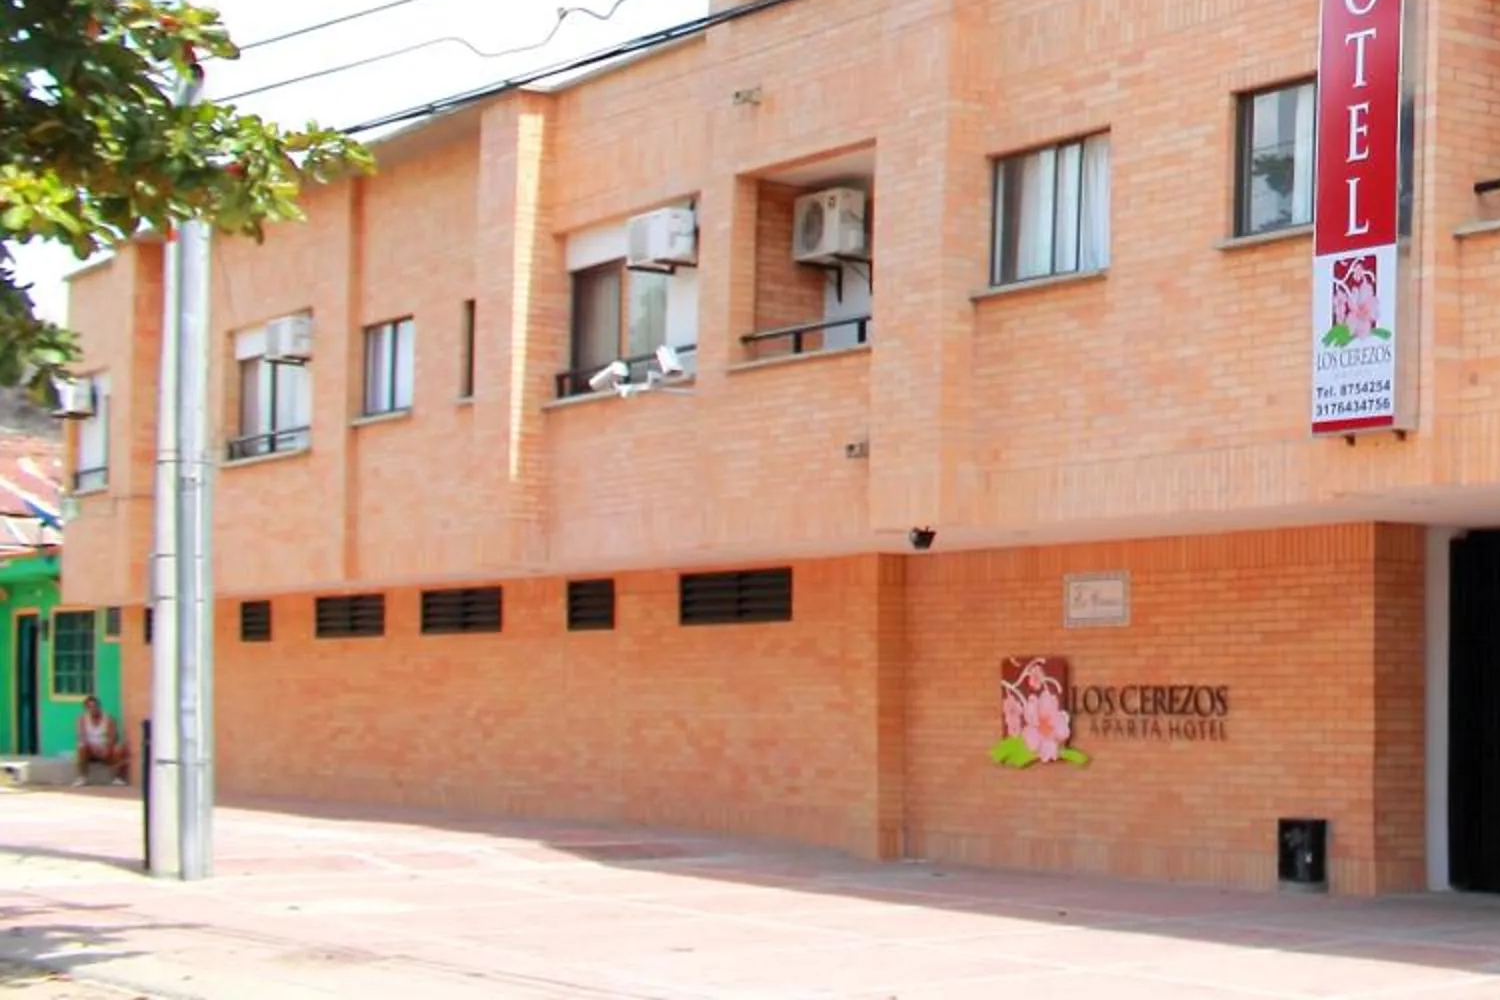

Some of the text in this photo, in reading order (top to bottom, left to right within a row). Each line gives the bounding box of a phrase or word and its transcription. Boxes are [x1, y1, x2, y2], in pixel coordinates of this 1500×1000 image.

[1317, 344, 1391, 371] LOS CEREZOS
[1316, 386, 1337, 399] Tel.
[1071, 685, 1229, 717] LOS CEREZOS
[1090, 719, 1228, 742] APARTA HOTEL
